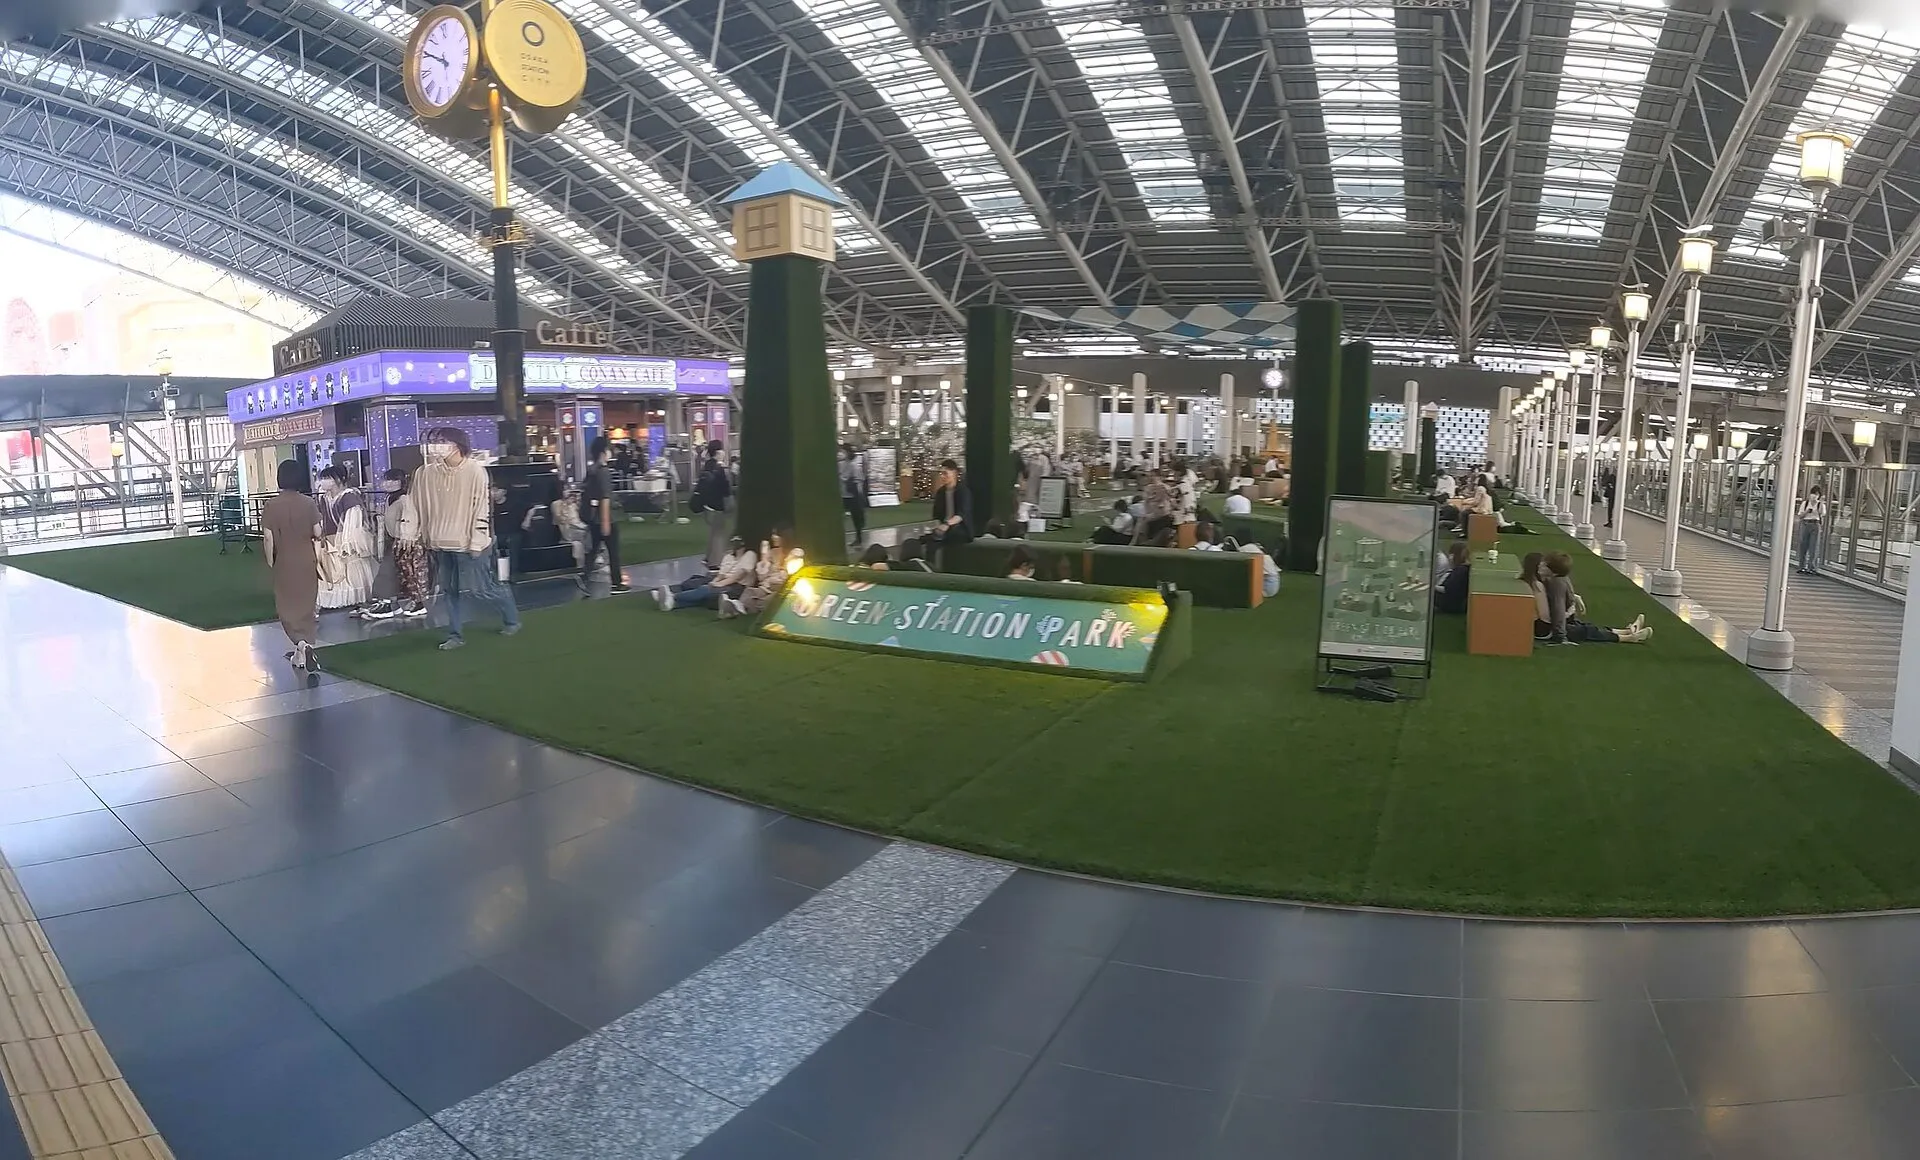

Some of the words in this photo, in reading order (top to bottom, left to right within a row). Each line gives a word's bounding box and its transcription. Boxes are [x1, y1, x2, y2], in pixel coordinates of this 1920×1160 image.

[580, 366, 627, 381] CONAN
[246, 423, 278, 439] DETECTIVE
[791, 594, 893, 624] GREEN
[894, 599, 1032, 639] STATION
[1036, 613, 1134, 649] PARK
